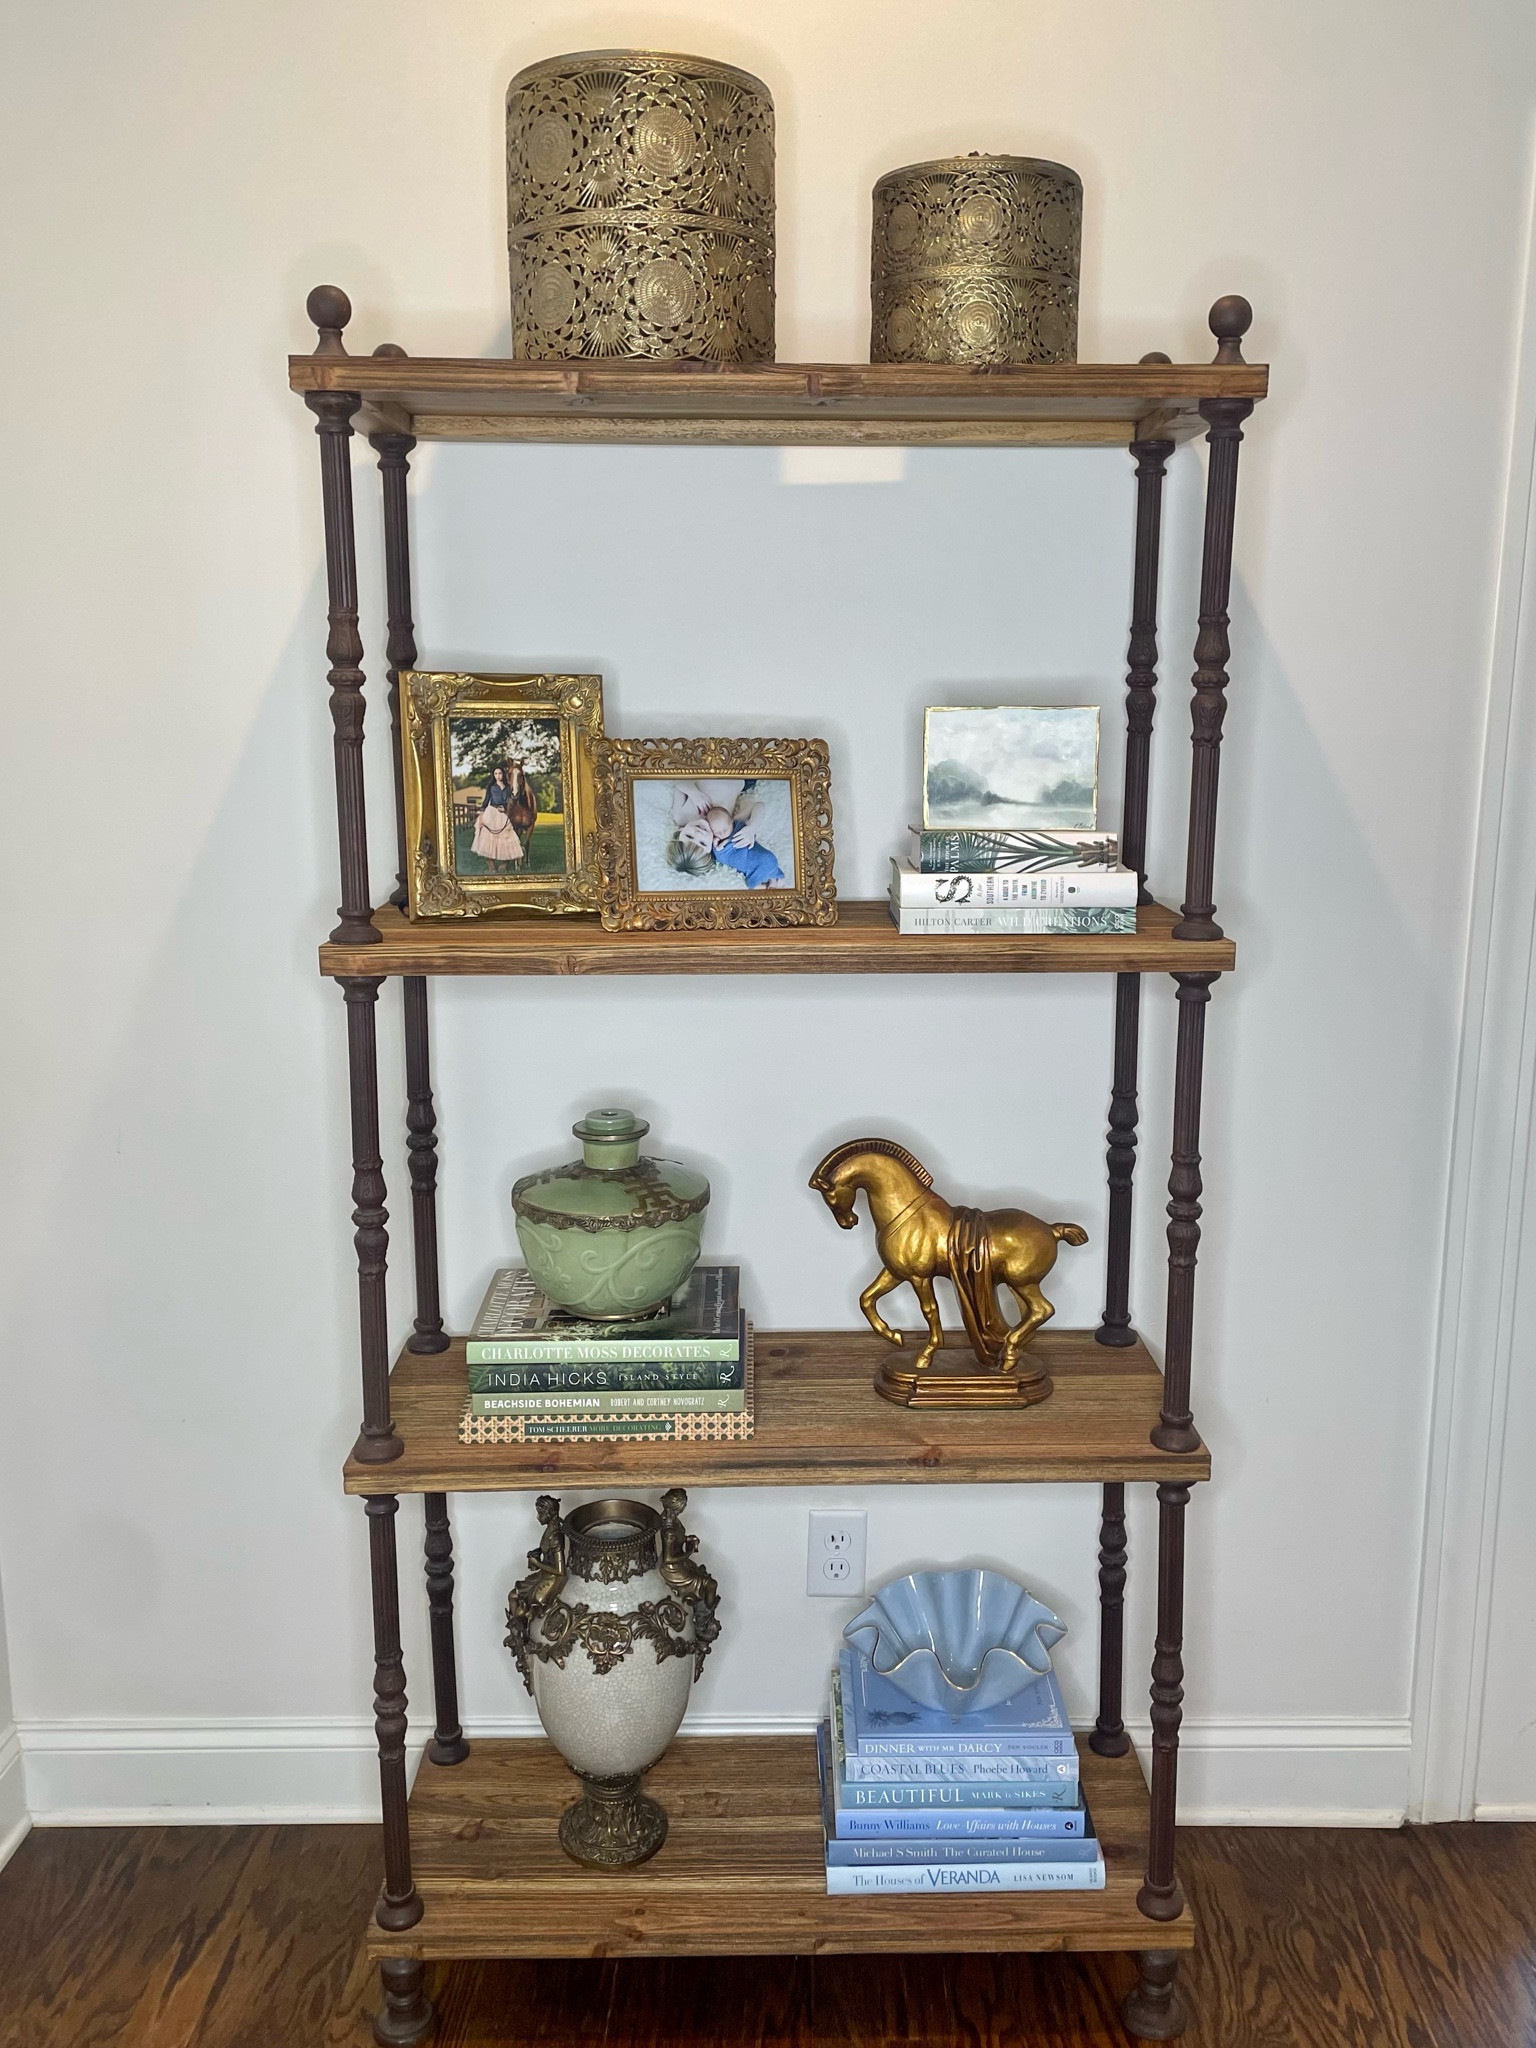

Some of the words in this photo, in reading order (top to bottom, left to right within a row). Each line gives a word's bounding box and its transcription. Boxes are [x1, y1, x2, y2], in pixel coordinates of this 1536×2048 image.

[950, 832, 960, 873] PALMS
[986, 876, 995, 905] SOUTHERN
[914, 918, 951, 926] HILTON
[954, 917, 992, 926] CARTER
[998, 916, 1031, 927] WILD
[1035, 916, 1108, 927] CREATIONS
[477, 1290, 510, 1338] CHARLOTTE
[494, 1270, 517, 1289] MOSS
[494, 1271, 536, 1336] DECORATES
[481, 1347, 573, 1360] CHARLOTTE
[577, 1346, 618, 1359] MOSS
[622, 1345, 711, 1359] DECORATES
[487, 1372, 541, 1386] INDIA
[547, 1371, 607, 1386] HICKS
[665, 1373, 698, 1381] STYLE
[484, 1399, 542, 1409] BEACHSIDE
[545, 1398, 600, 1408] BOHEMIAN
[610, 1398, 630, 1407] ROBERT
[632, 1398, 645, 1407] AND
[646, 1397, 671, 1407] CORTNEY
[673, 1397, 705, 1406] NOVOGRATZ
[546, 1425, 588, 1433] SCHEERER
[612, 1423, 661, 1432] DECORATING
[865, 1743, 915, 1754] DINNER
[958, 1743, 1002, 1753] DARCY
[861, 1764, 922, 1775] COASTAL
[925, 1763, 965, 1774] BLUES
[973, 1763, 1008, 1774] Phoebe
[1010, 1763, 1048, 1774] Howard
[856, 1788, 964, 1804] BEAUTIFUL
[971, 1791, 1002, 1799] MARK
[1014, 1790, 1046, 1799] SIKES
[849, 1819, 881, 1833] Bunny
[884, 1819, 930, 1830] Williams
[936, 1819, 960, 1830] Love
[964, 1819, 996, 1833] Affairs
[997, 1819, 1019, 1830] with
[1021, 1819, 1057, 1830] Houses
[853, 1847, 893, 1858] Michael
[896, 1847, 904, 1857] S
[905, 1846, 938, 1857] Smith
[943, 1846, 964, 1857] The
[967, 1846, 1009, 1857] Curated
[1012, 1846, 1046, 1857] House
[852, 1875, 872, 1886] The
[876, 1874, 912, 1886] Houses
[914, 1873, 925, 1884] of
[927, 1868, 1001, 1887] VERANDA
[1036, 1873, 1074, 1882] NEWSOM
